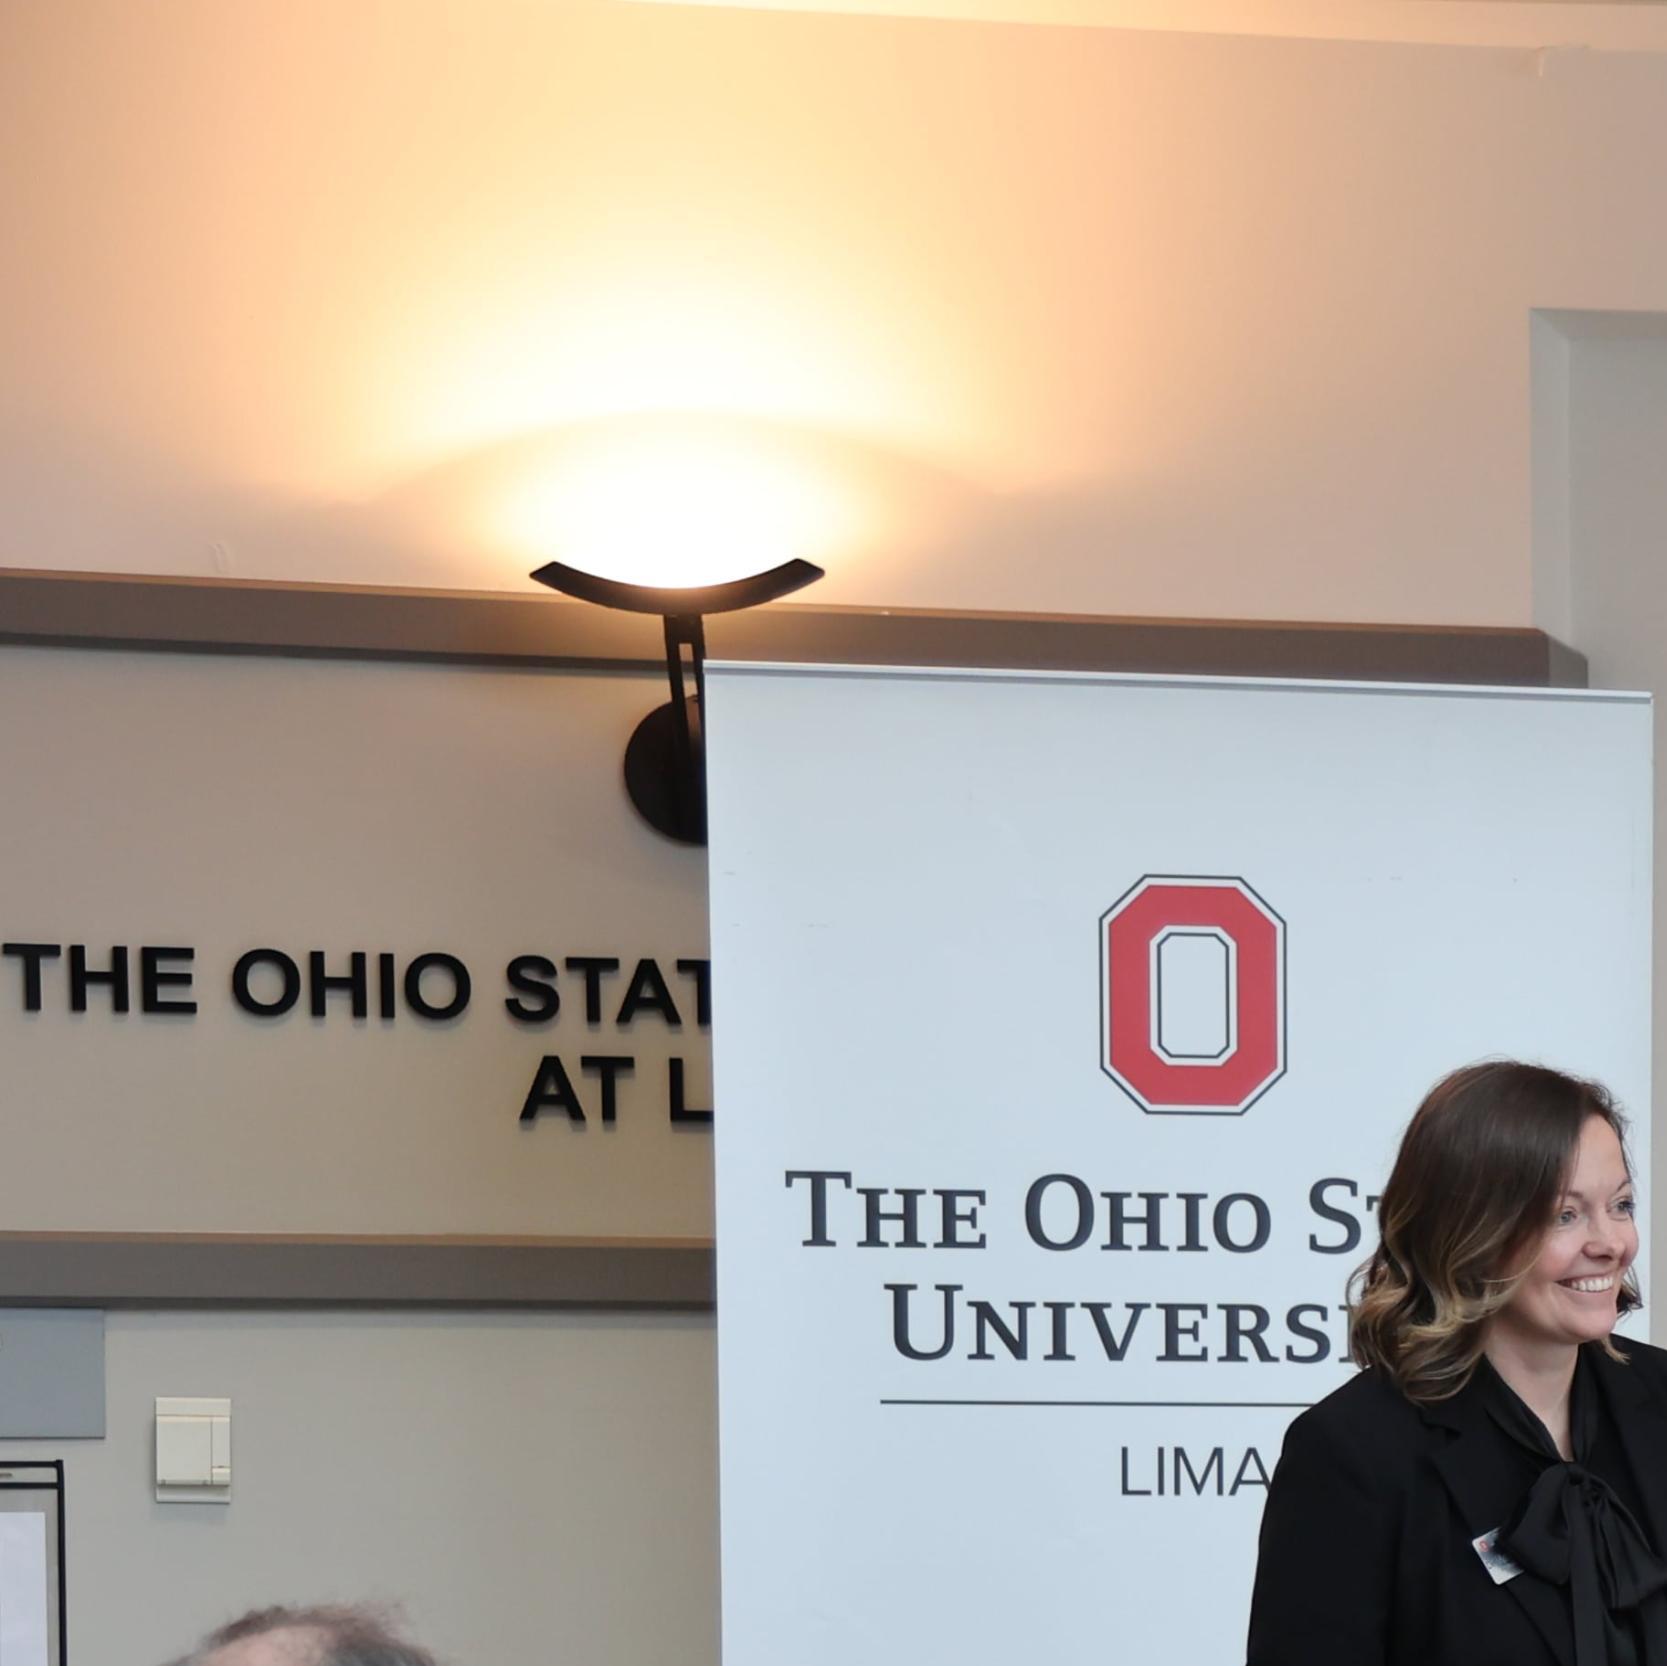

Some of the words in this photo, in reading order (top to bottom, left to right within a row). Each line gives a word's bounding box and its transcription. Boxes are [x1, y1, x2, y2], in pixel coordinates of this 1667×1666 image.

[2, 943, 198, 1014] THE
[232, 948, 472, 1020] OHIO
[1099, 874, 1287, 1116] O
[519, 1055, 635, 1122] AT
[669, 1057, 715, 1122] L
[785, 1170, 987, 1250] THE
[1025, 1173, 1272, 1255] OHIO
[1308, 1176, 1382, 1256] S
[1120, 1446, 1272, 1498] LIMA
